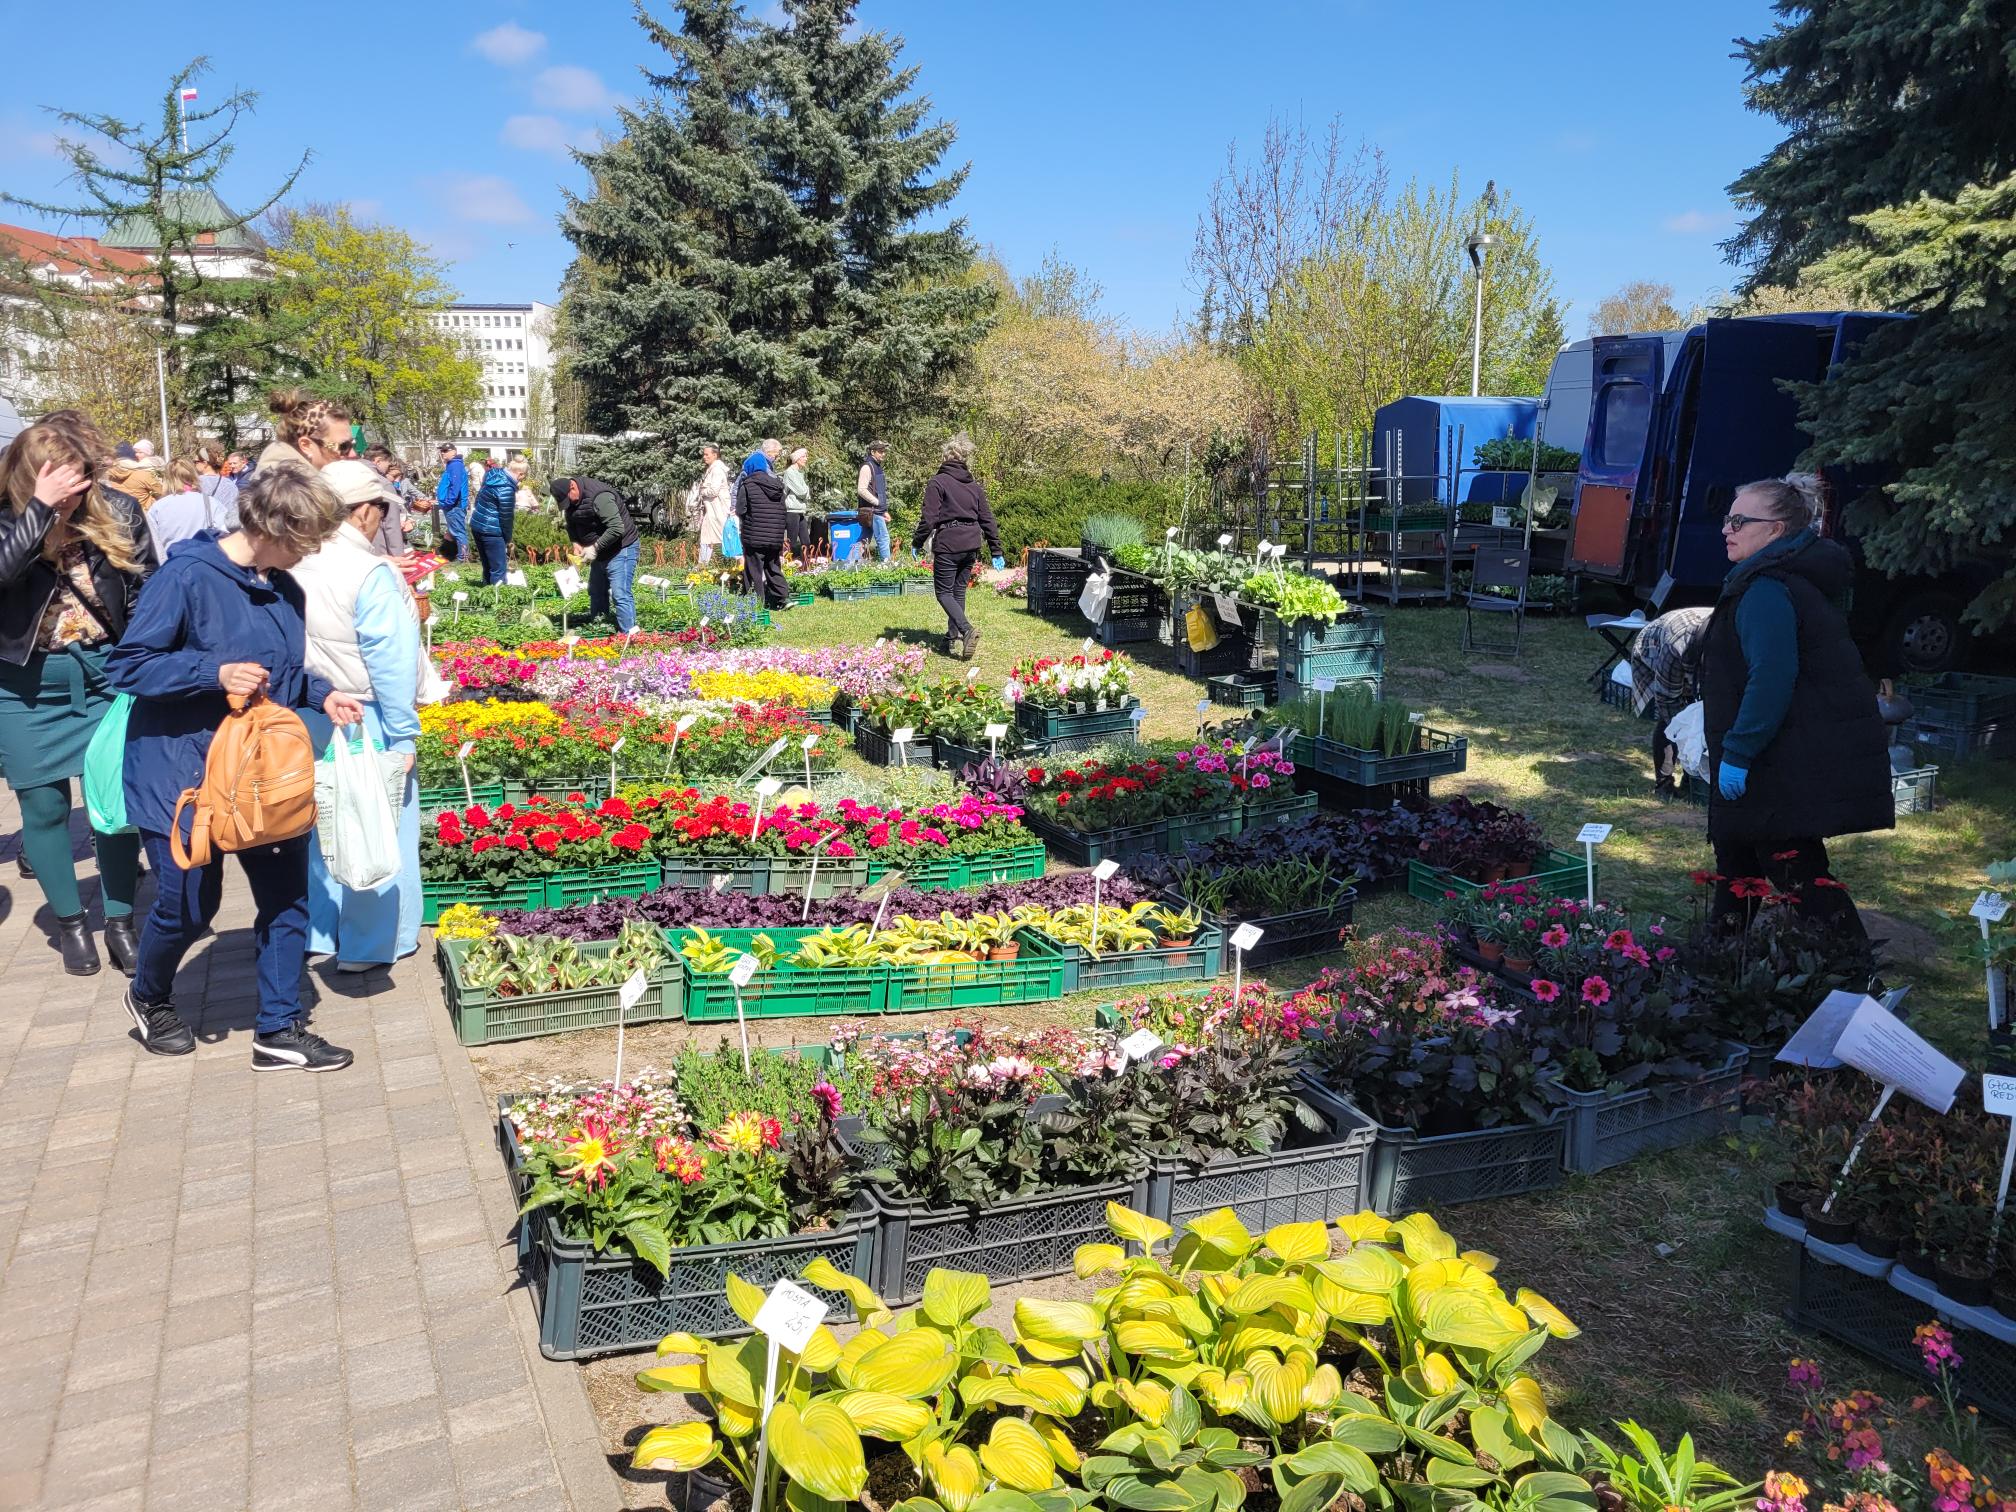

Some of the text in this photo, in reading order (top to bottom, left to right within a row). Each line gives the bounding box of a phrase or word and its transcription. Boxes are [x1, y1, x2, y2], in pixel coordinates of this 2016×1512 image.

[1988, 1079, 2016, 1090] GŁOG
[1991, 1090, 2014, 1100] RED
[781, 1288, 812, 1308] HOSTA
